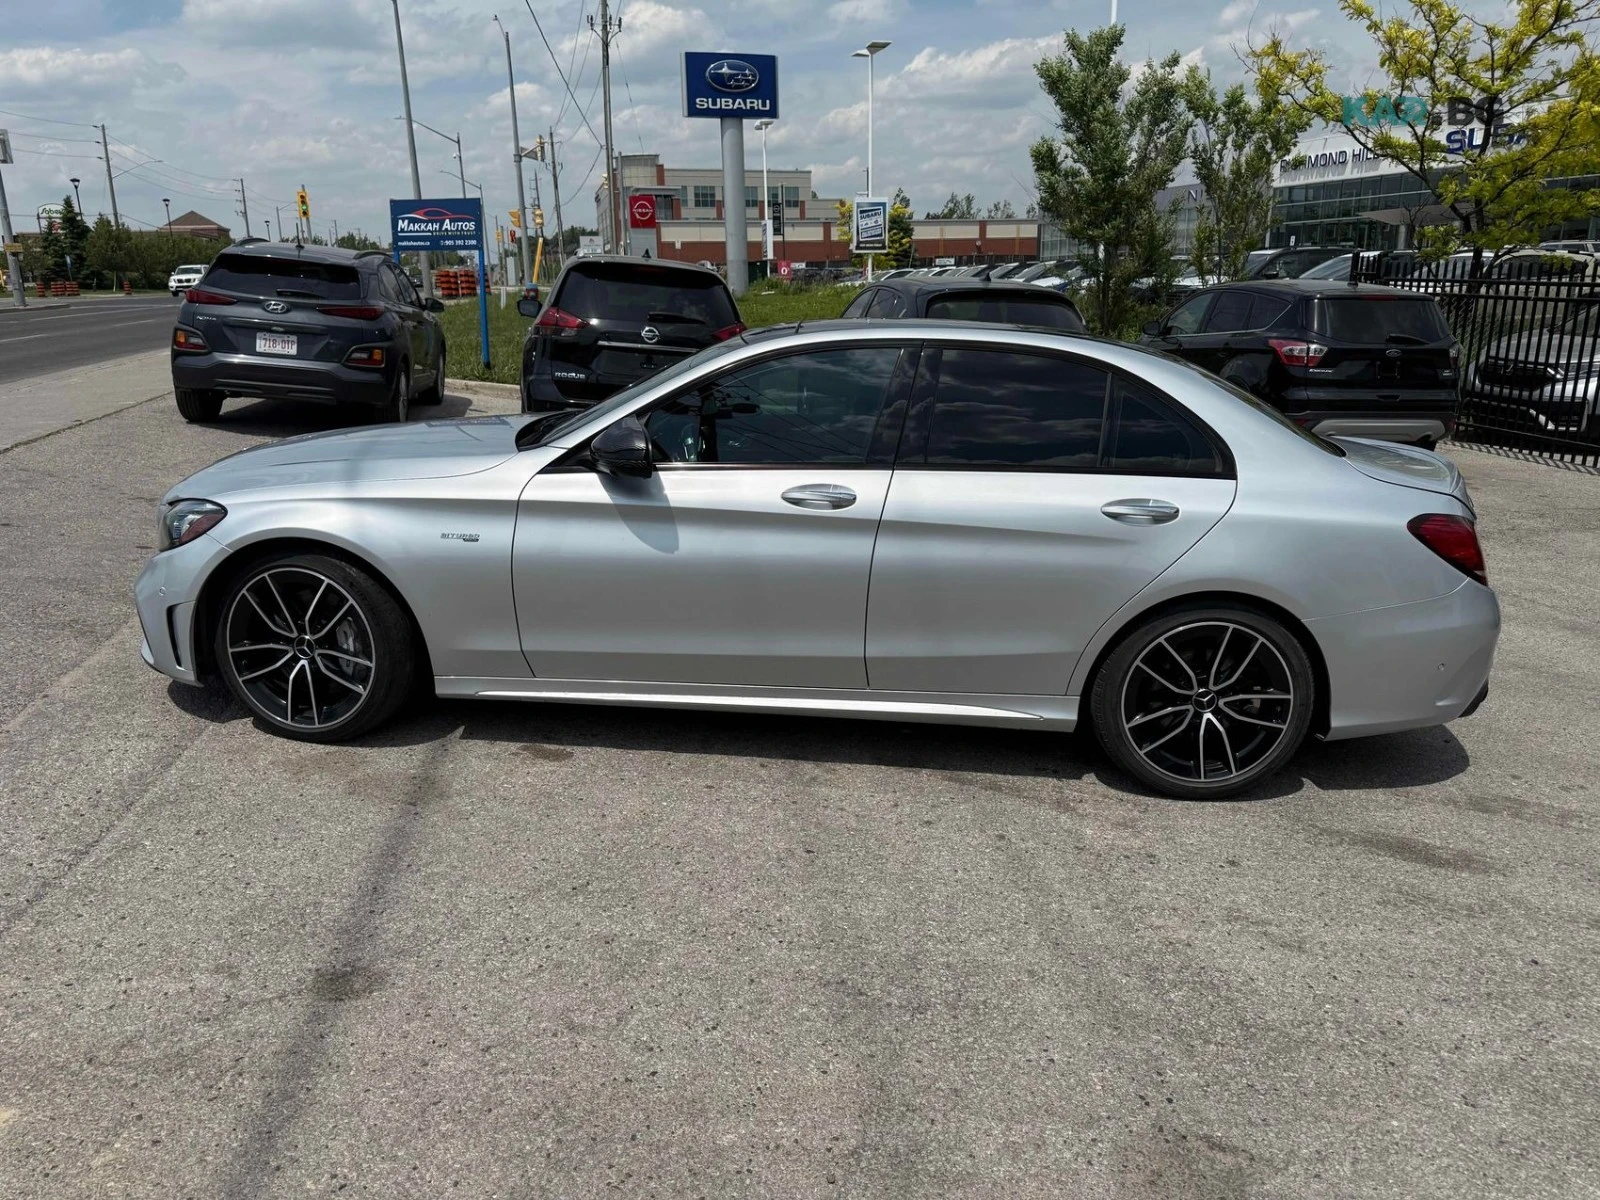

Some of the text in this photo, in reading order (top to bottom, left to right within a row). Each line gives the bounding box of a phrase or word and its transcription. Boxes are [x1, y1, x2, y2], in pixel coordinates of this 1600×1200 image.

[695, 97, 770, 111] SUBARU
[41, 207, 65, 215] Sobey
[860, 211, 881, 220] SUBARU
[398, 218, 476, 232] MAKKAH AUTOS
